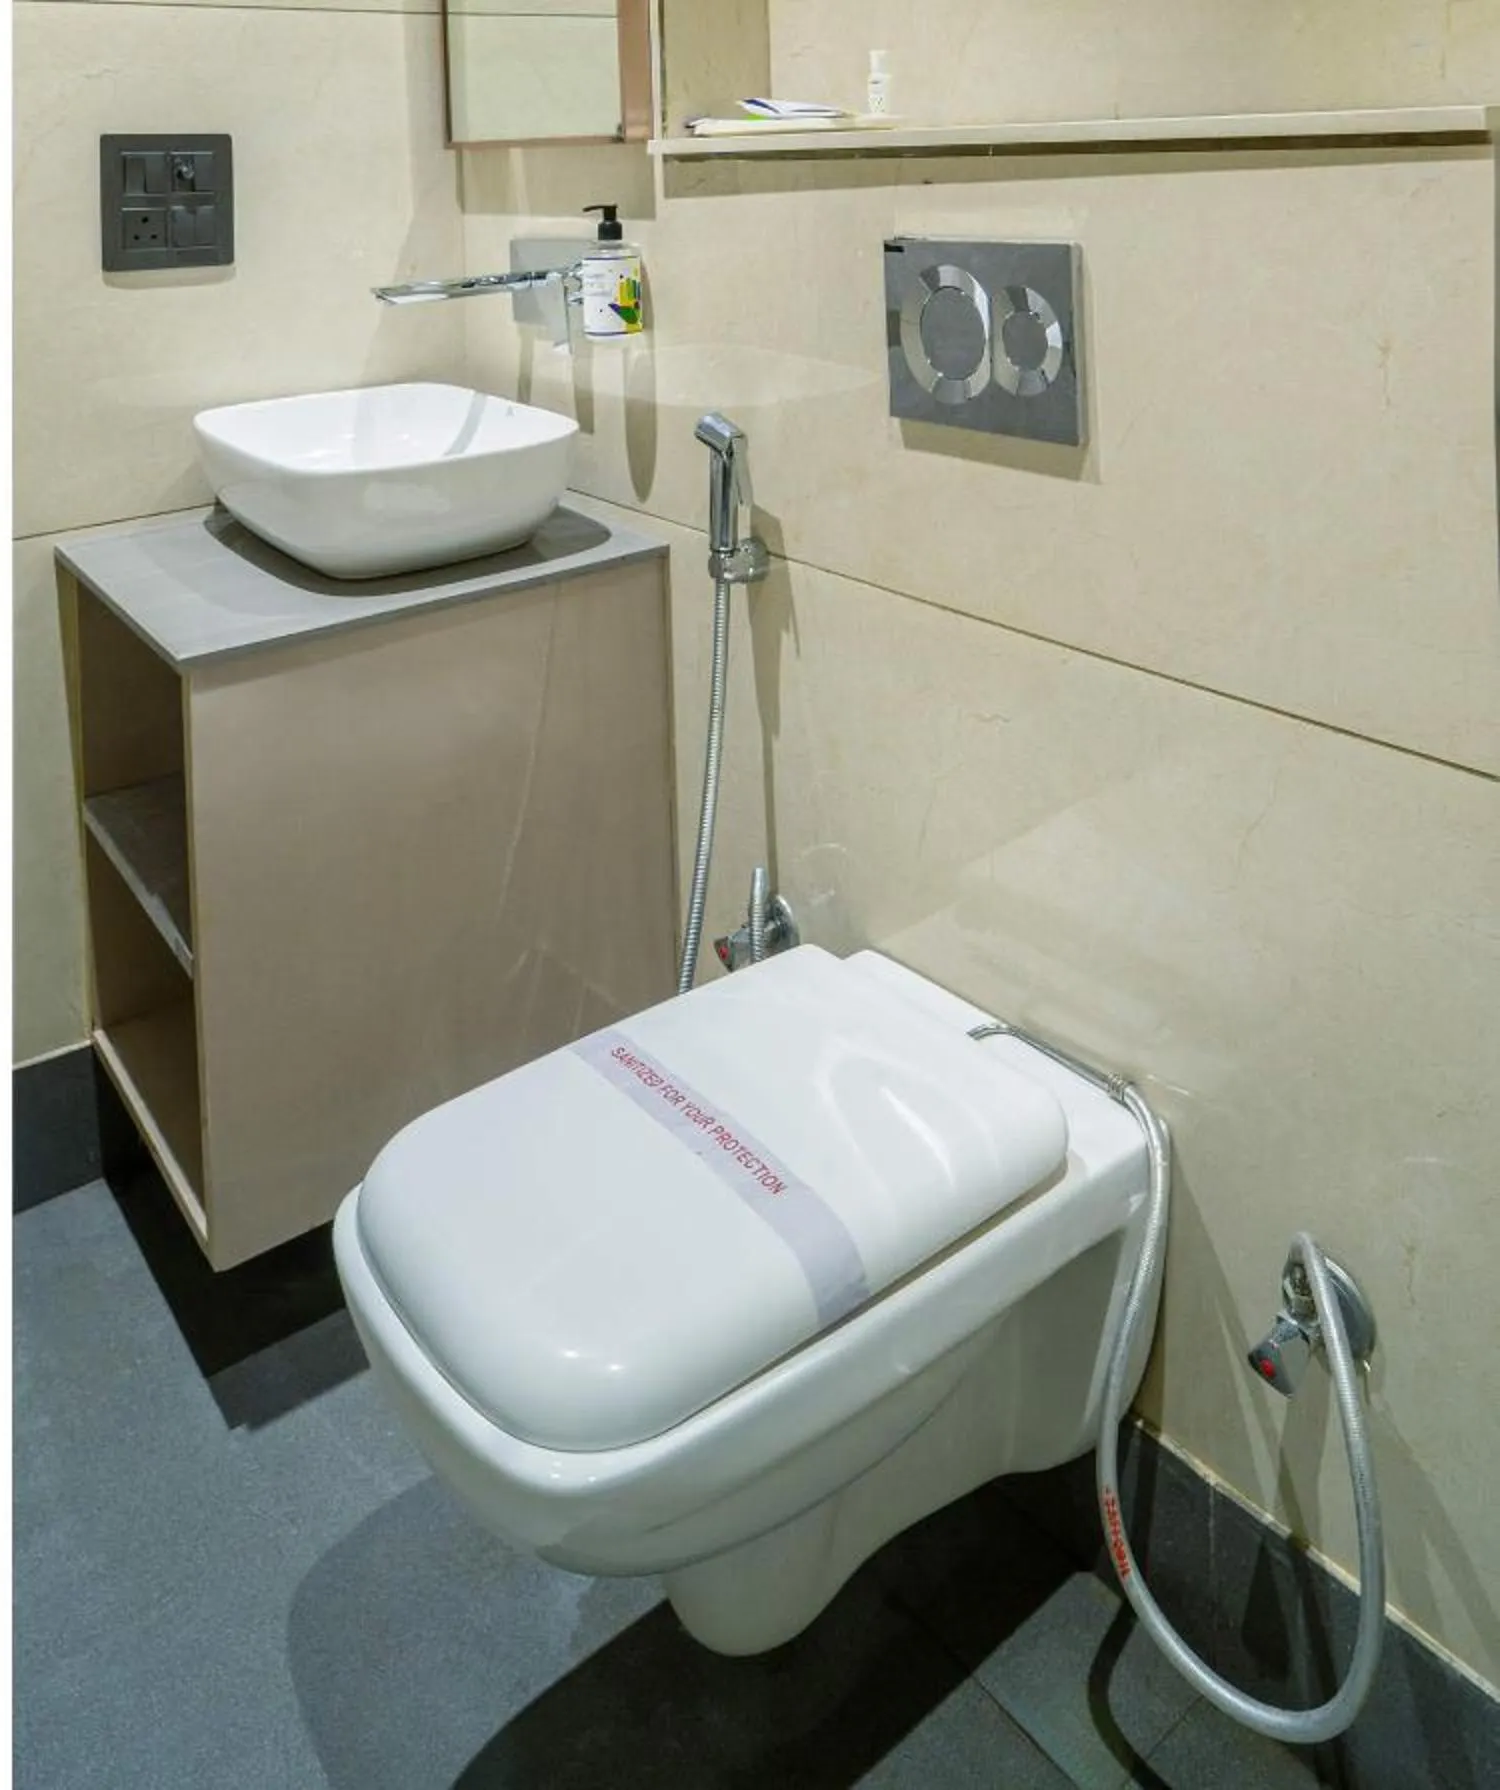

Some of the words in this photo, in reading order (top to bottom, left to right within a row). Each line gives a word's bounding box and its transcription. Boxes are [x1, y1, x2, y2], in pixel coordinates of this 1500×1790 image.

[611, 1046, 664, 1087] SANITIZED
[659, 1084, 686, 1106] FOR
[680, 1102, 716, 1129] YOUR
[708, 1125, 789, 1195] PROTECTION
